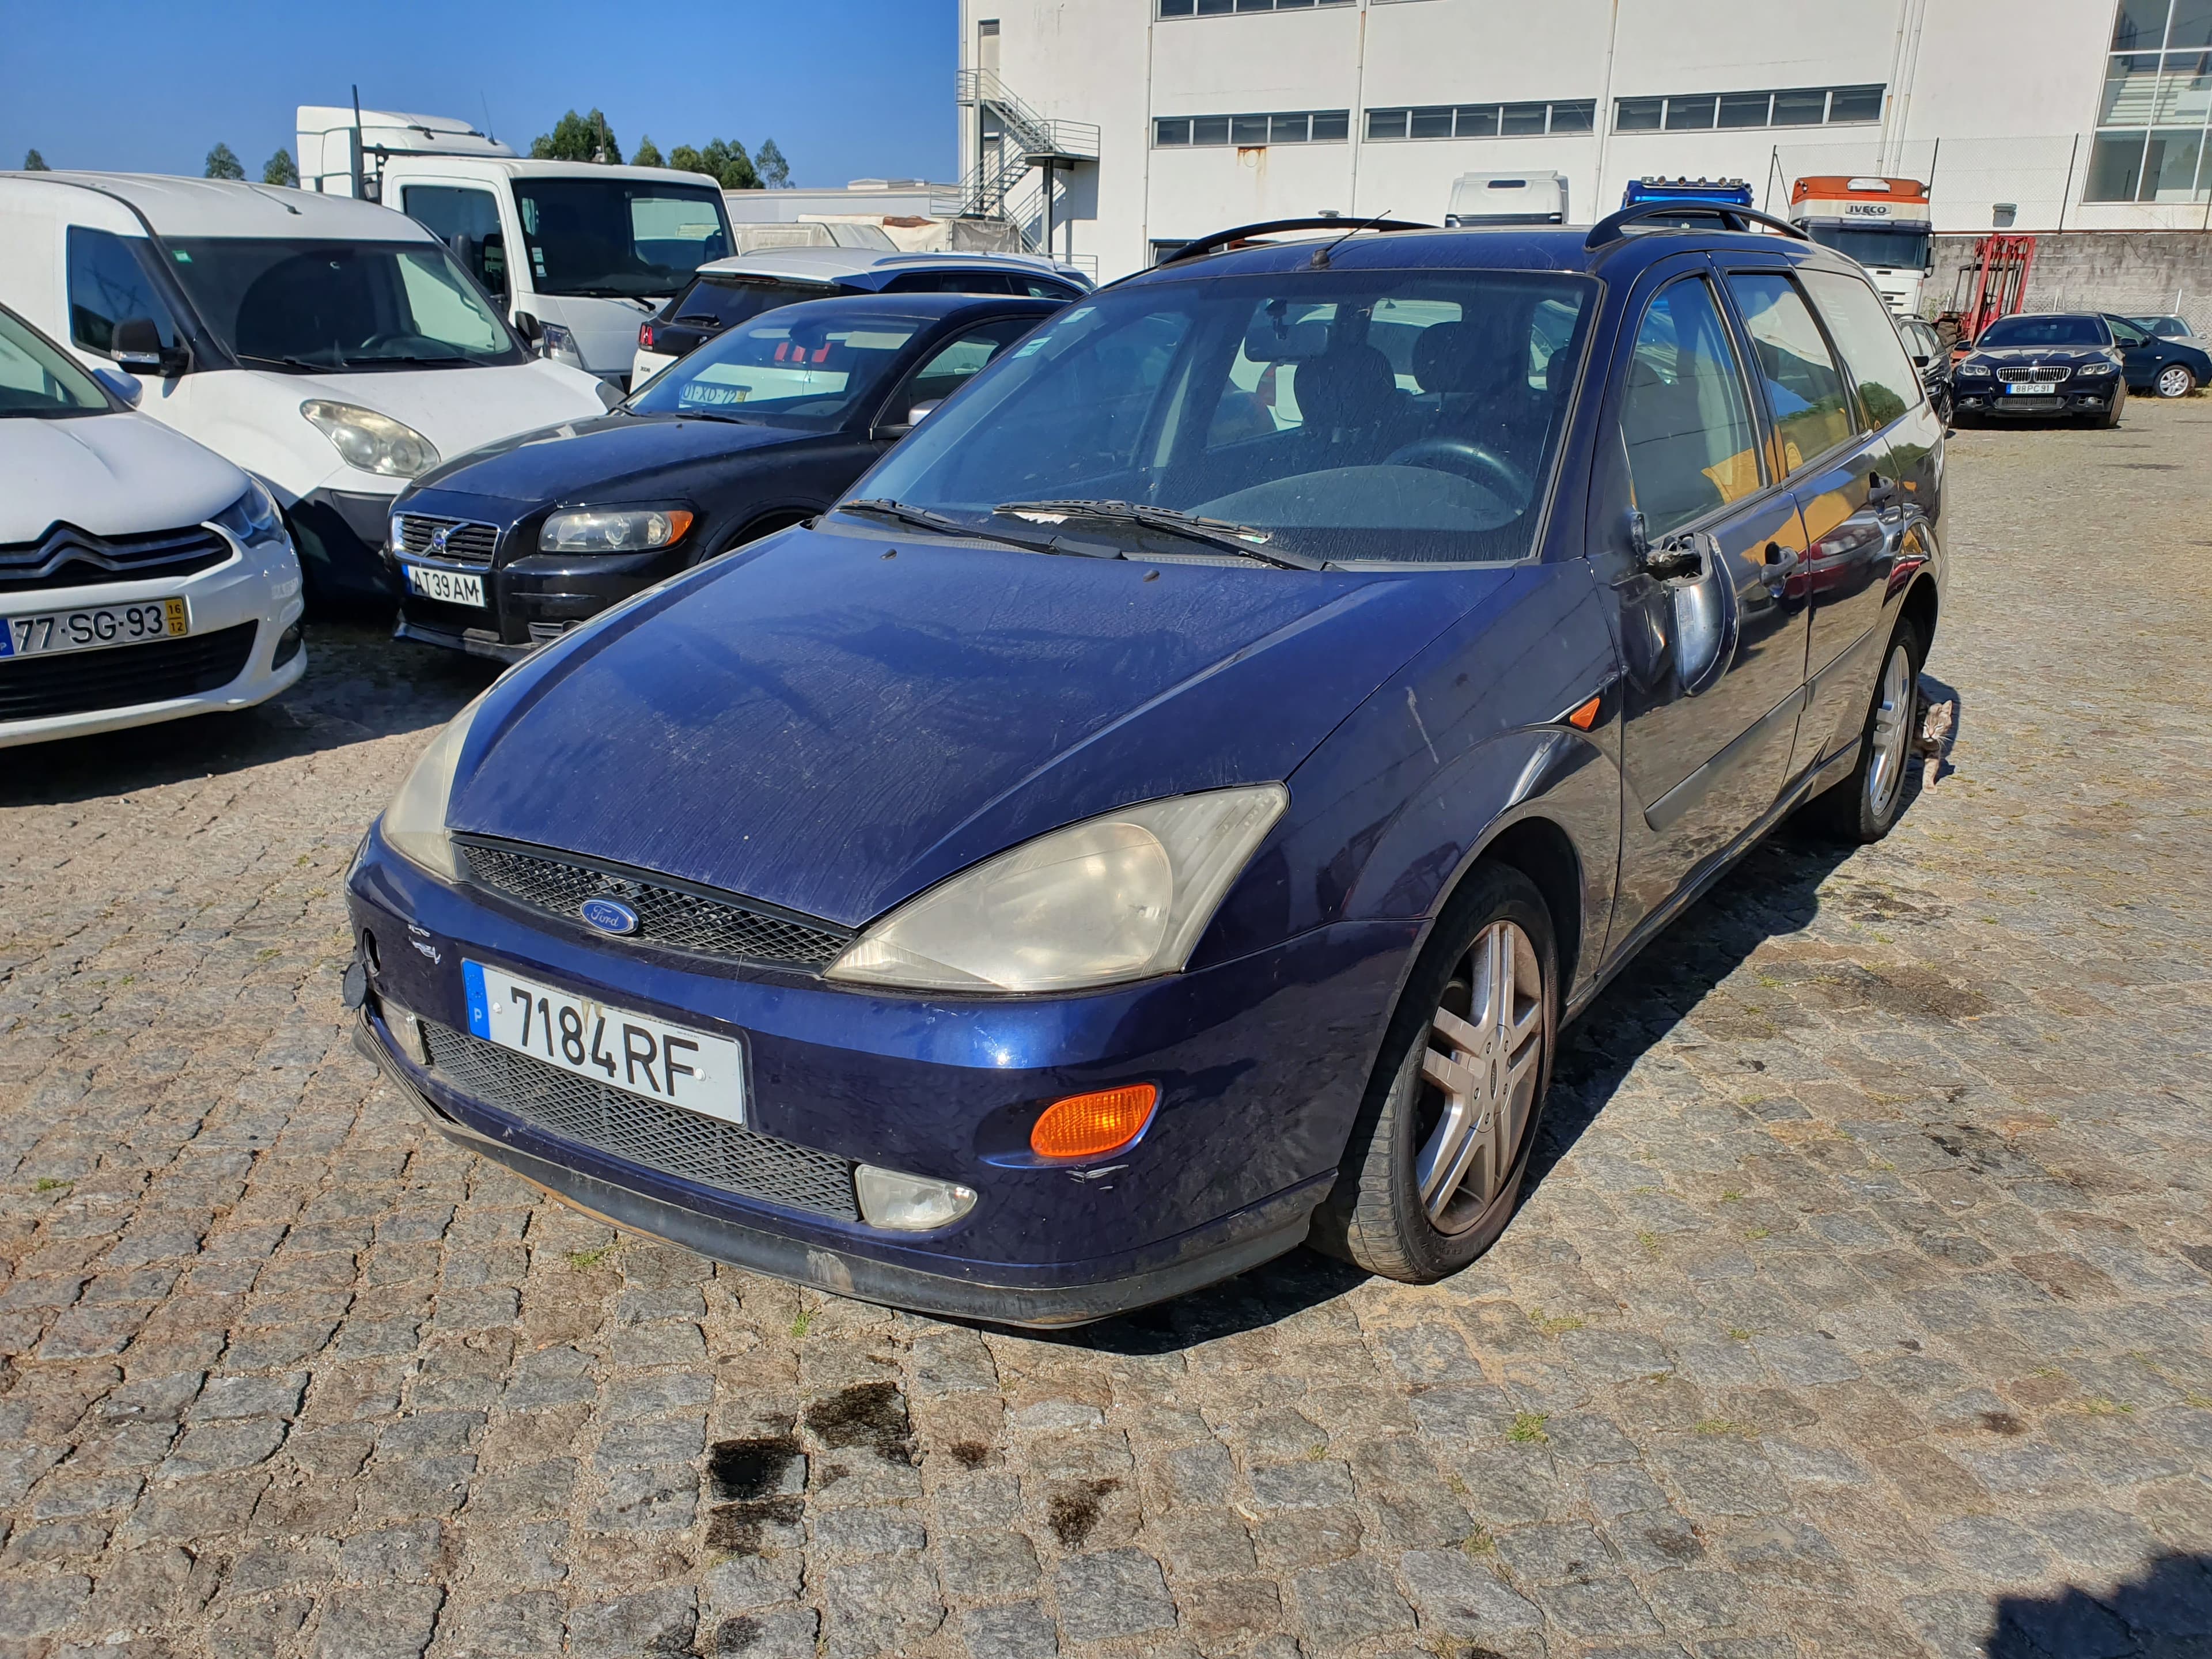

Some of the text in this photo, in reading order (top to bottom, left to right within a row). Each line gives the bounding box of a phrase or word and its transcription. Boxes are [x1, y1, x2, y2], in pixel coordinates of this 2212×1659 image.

[1850, 205, 1887, 213] IVECO
[169, 604, 181, 615] 16
[171, 622, 184, 632] 12
[0, 642, 7, 651] P
[474, 986, 699, 1097] P 7184RF
